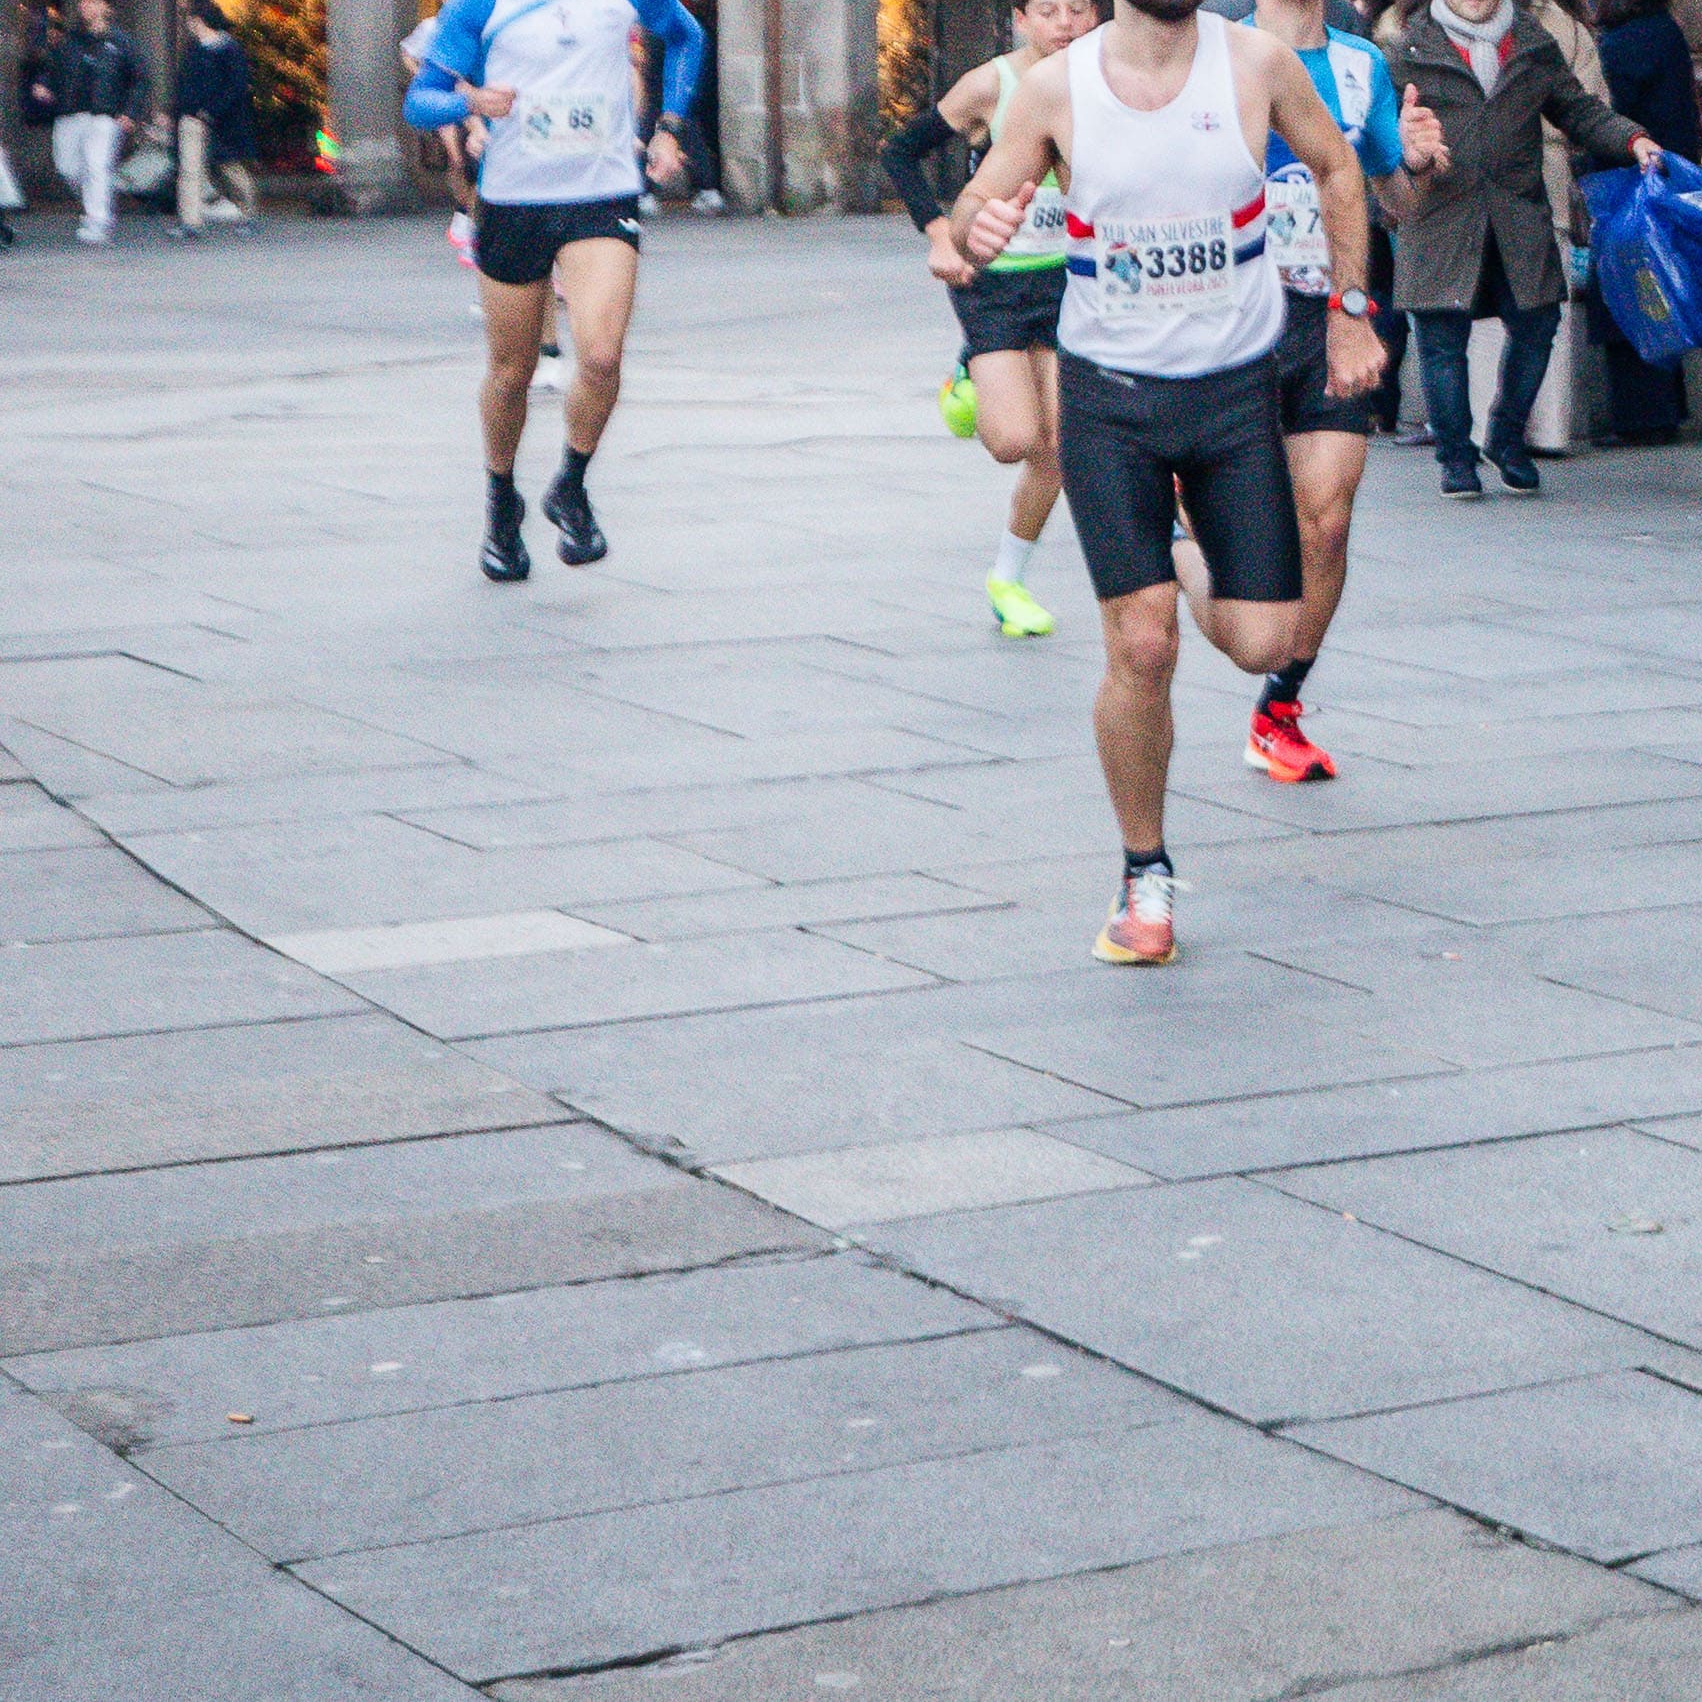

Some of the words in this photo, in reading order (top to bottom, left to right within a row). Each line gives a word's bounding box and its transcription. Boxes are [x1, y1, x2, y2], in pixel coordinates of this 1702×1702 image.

[1129, 224, 1156, 242] SAN
[1161, 217, 1225, 241] SILVESTRE
[1146, 238, 1227, 279] 3388
